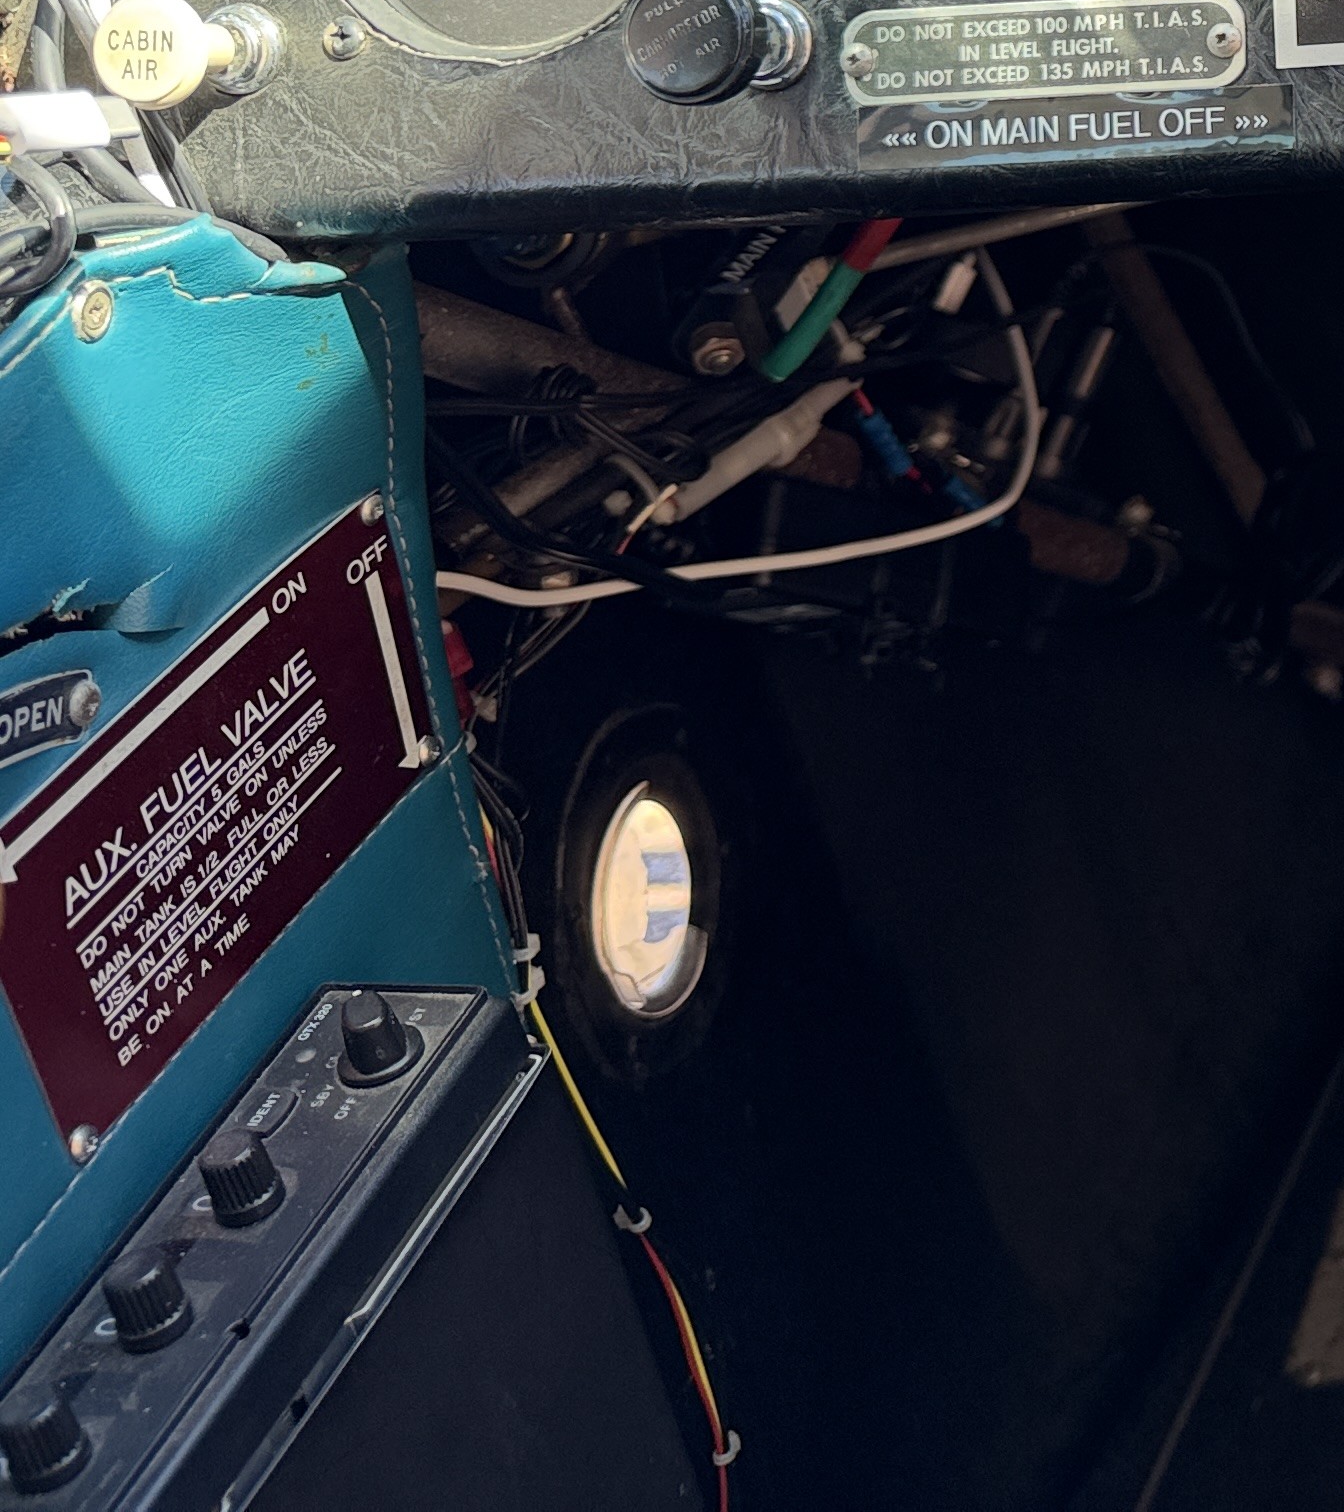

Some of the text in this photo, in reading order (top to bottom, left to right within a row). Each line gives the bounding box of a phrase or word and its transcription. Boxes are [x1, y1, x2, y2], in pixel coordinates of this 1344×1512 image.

[108, 29, 173, 52] CABIN
[876, 24, 905, 44] DO
[915, 22, 953, 41] NOT
[962, 18, 1030, 38] EXCEED
[1034, 16, 1068, 35] 100
[1074, 13, 1125, 33] MPH
[959, 37, 1119, 61] IN LEVEL FLIGHT.
[121, 59, 158, 80] AIR
[877, 70, 906, 89] DO
[914, 68, 953, 88] NOT
[962, 64, 1030, 85] EXCEED
[1041, 62, 1074, 82] 135
[1081, 59, 1130, 79] MPH
[926, 105, 1226, 150] ON MAIN FUEL OFF
[345, 535, 388, 585] OFF
[272, 572, 307, 615] ON
[0, 696, 63, 744] OPEN
[64, 650, 313, 917] AUX. FUEL VALVE
[135, 740, 265, 878] CAPACITY 5 GALS
[79, 707, 328, 969] DO NOT TURN VALVE ON UNLESS
[246, 1092, 282, 1128] IDENT
